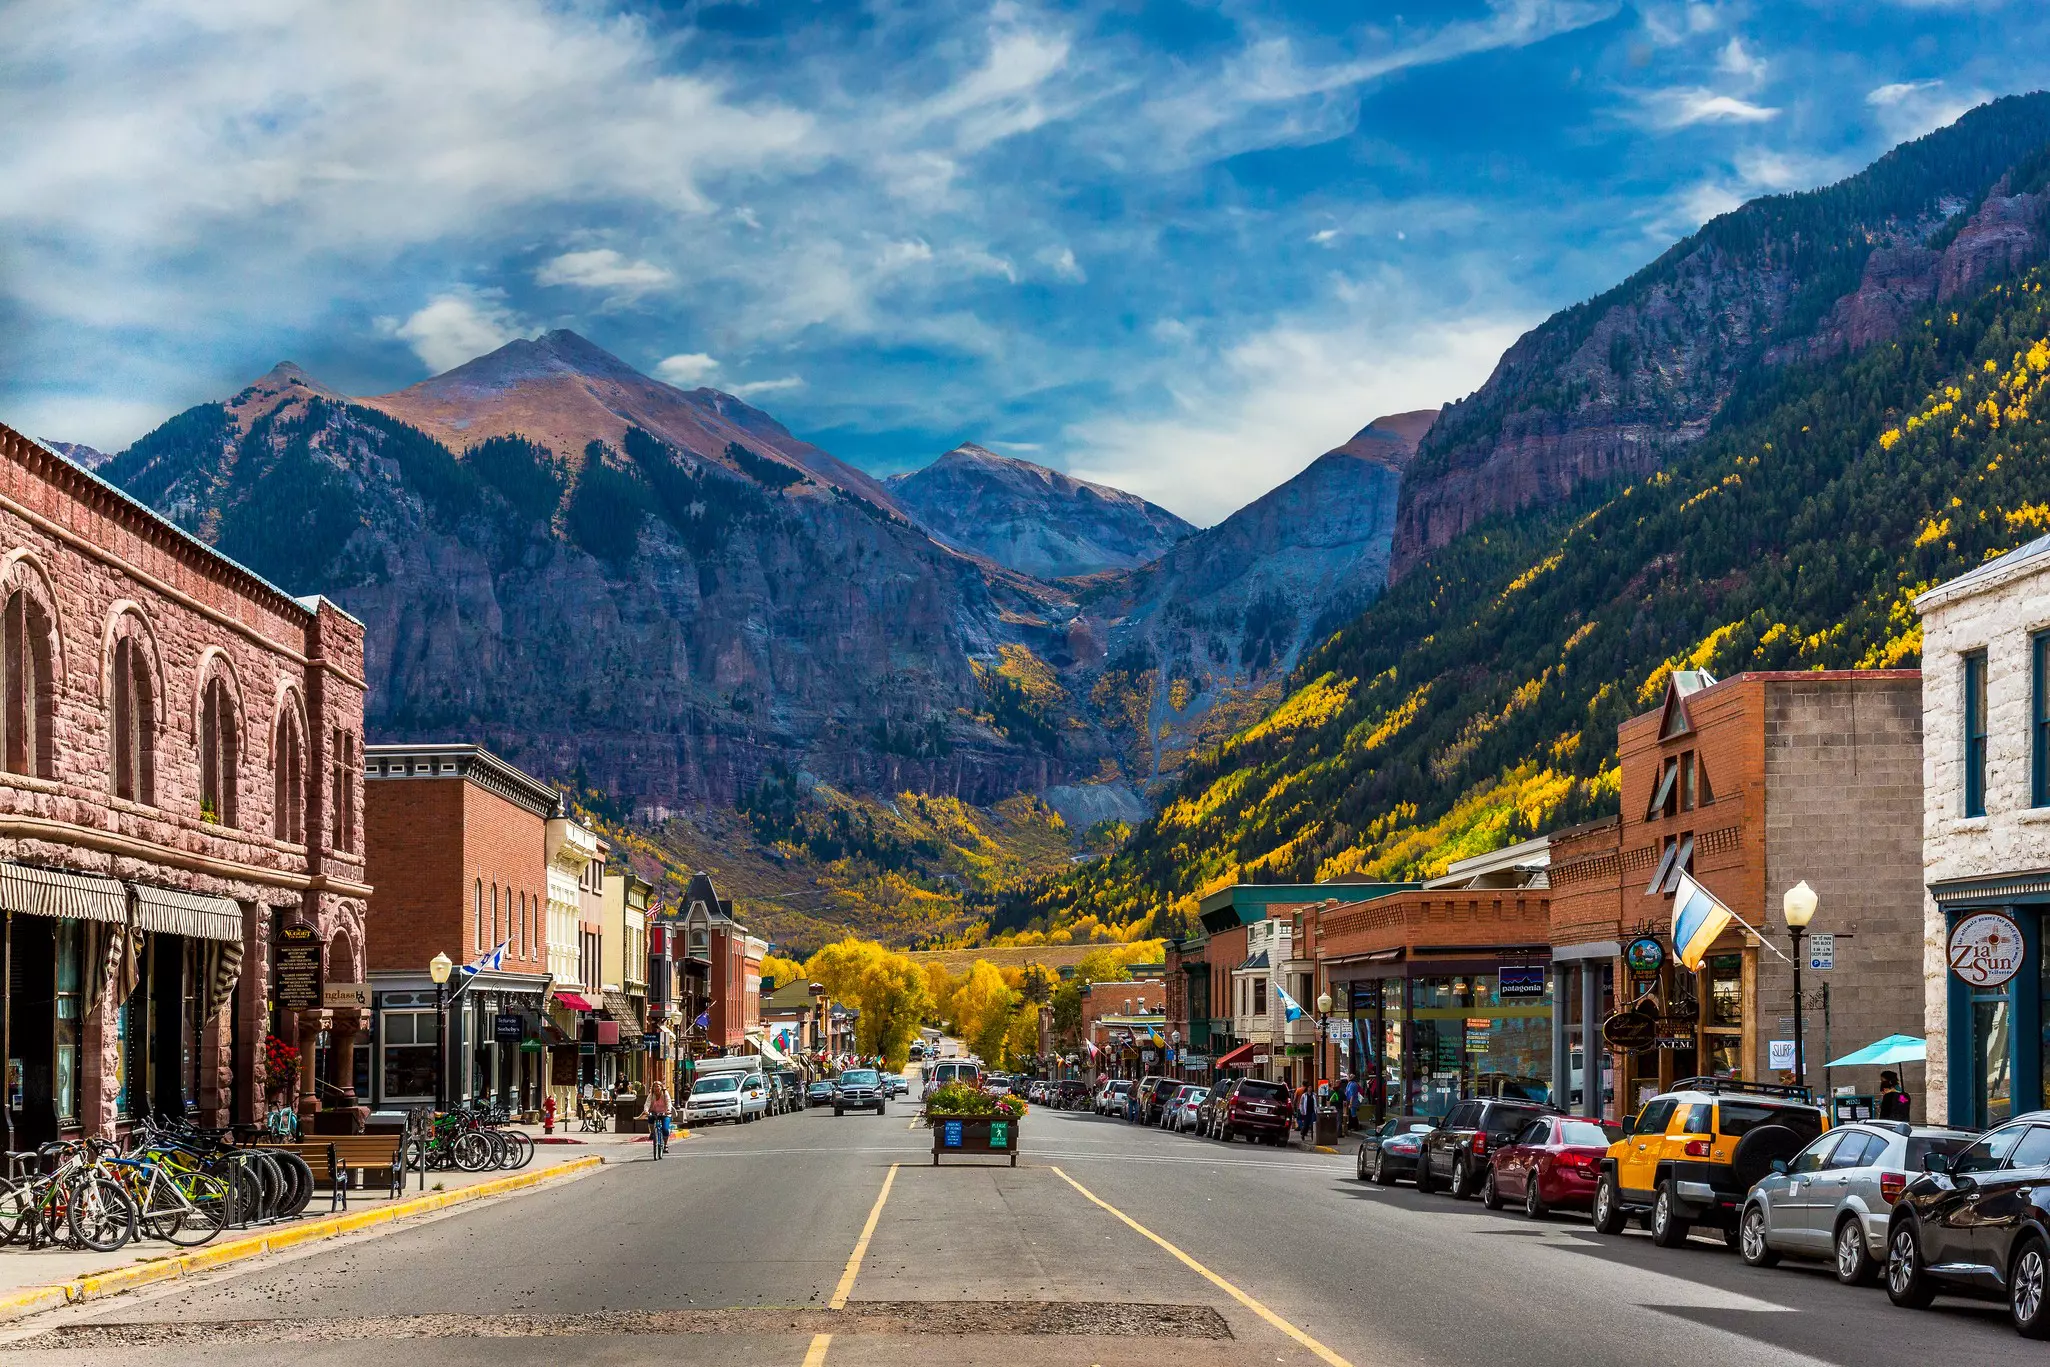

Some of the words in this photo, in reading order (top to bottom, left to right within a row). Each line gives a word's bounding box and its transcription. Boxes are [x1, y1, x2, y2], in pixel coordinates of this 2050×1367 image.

[1951, 941, 1990, 969] Zia
[1973, 958, 2012, 981] Sun
[1502, 984, 1541, 993] patagonia
[1772, 1044, 1792, 1056] SLURP
